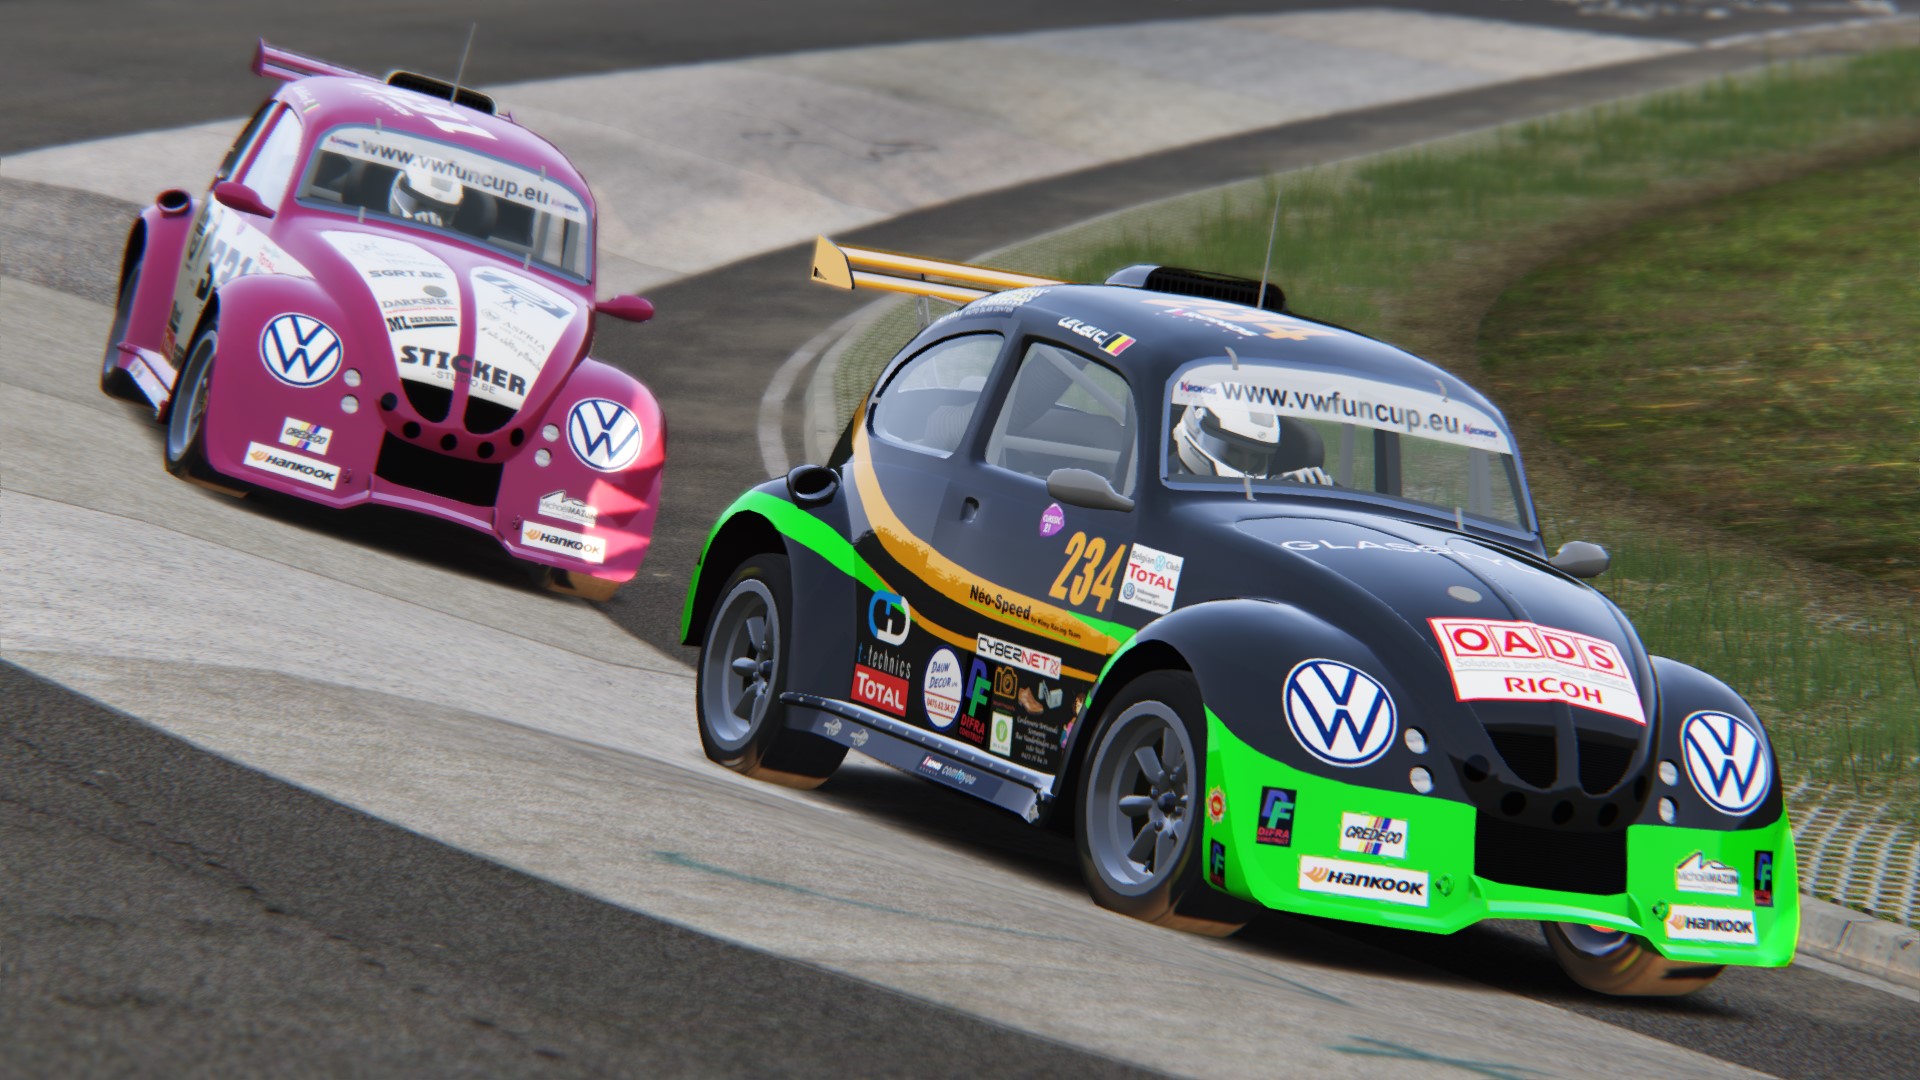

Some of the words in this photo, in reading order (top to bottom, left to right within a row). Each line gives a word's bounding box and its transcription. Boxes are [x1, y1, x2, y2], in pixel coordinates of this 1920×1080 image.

[363, 140, 549, 206] www.vwfuncup.eu
[386, 315, 412, 332] ML
[400, 345, 527, 396] STICKER
[1221, 382, 1460, 434] www.vwfuncup.eu
[1131, 551, 1155, 563] Belgian
[1048, 531, 1127, 613] 234
[1129, 562, 1175, 591] TOTAL
[969, 584, 1031, 620] Néo-Speed
[1453, 628, 1615, 669] OADS
[1455, 658, 1511, 669] Solutions
[856, 671, 904, 711] TOTAL
[929, 676, 952, 689] DECOR
[1504, 676, 1604, 705] RICOH
[960, 713, 985, 735] DIFRA
[1345, 825, 1403, 844] CREDECO
